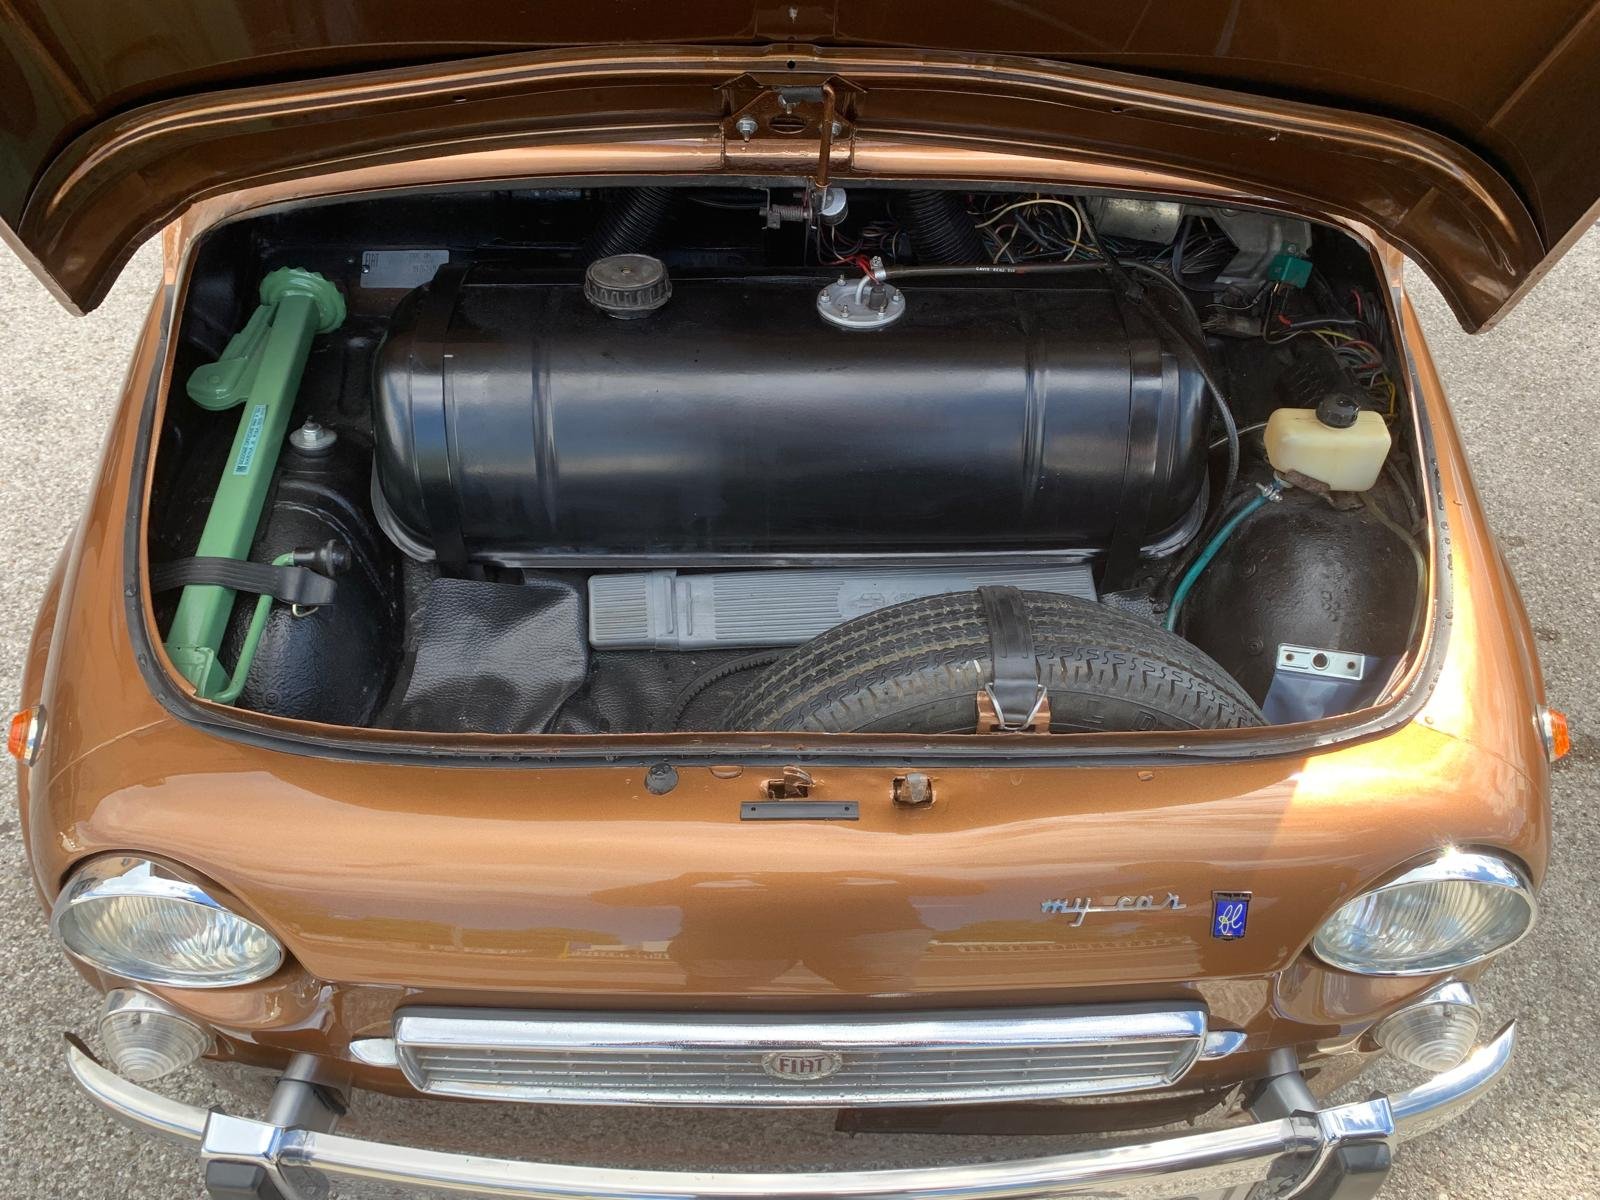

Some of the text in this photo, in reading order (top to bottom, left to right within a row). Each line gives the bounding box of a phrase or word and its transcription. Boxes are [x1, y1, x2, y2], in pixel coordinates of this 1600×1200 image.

[1040, 891, 1187, 927] my car
[779, 1057, 825, 1073] FIAT
